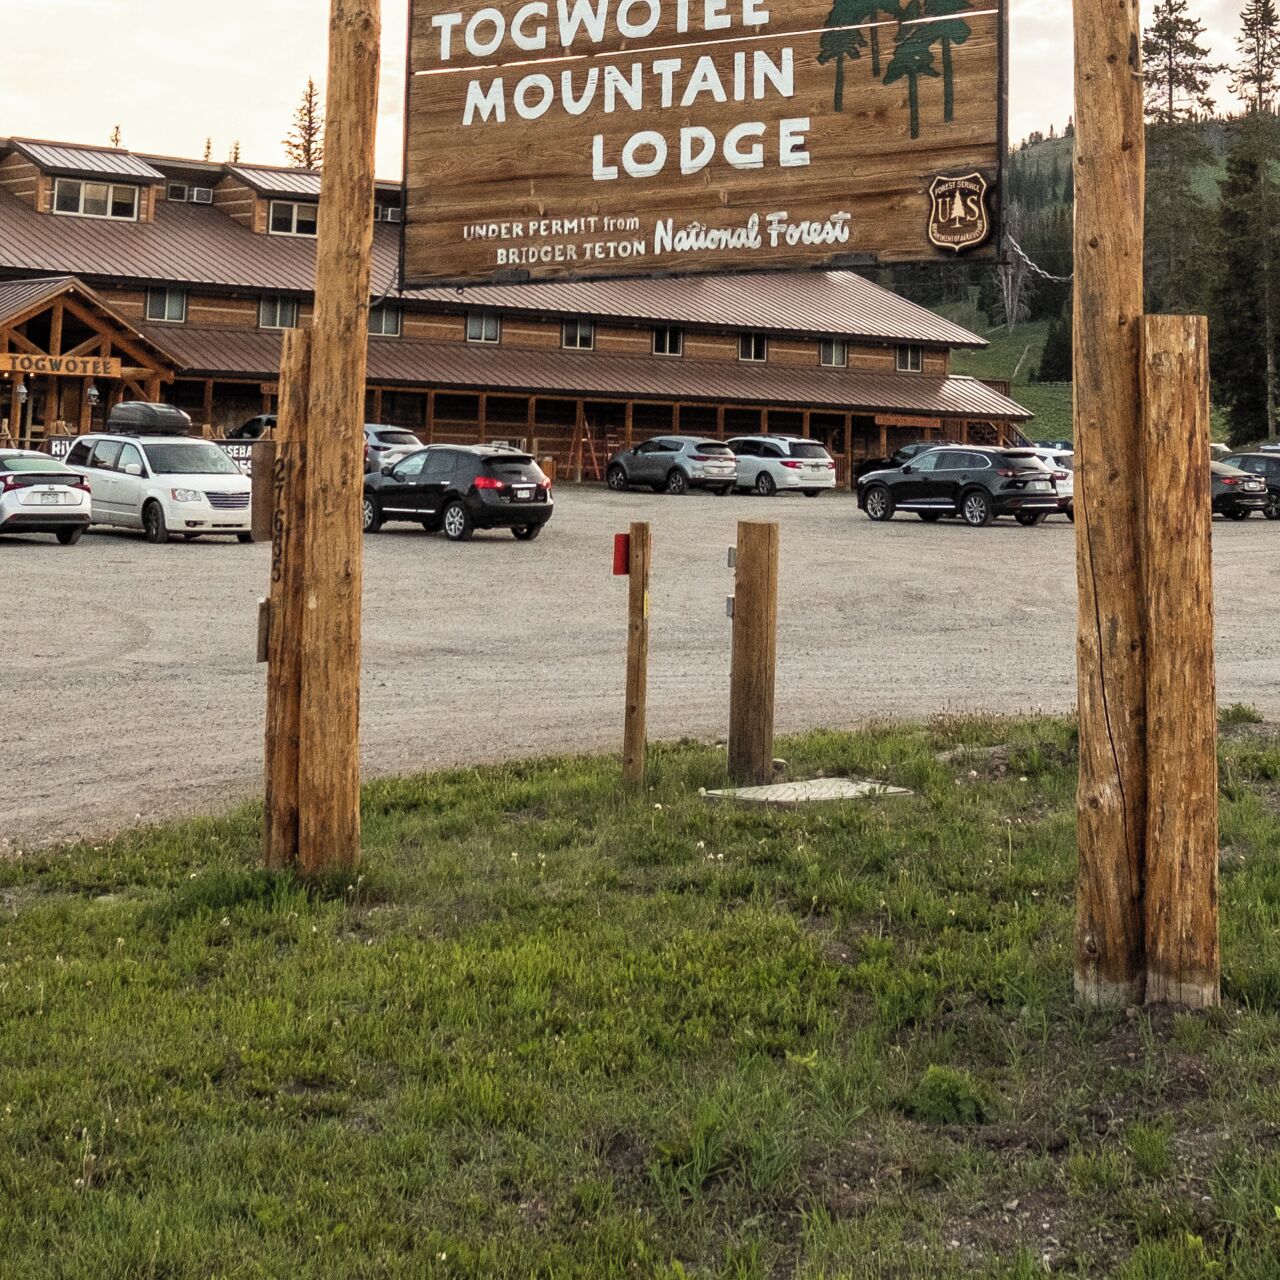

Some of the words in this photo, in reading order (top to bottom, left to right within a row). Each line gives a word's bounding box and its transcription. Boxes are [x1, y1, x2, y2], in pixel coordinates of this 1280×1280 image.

[462, 47, 794, 125] MOUNTAIN
[592, 117, 811, 180] LODGE
[463, 222, 524, 240] UNDER
[528, 217, 599, 237] PERMIT
[603, 216, 640, 232] from
[654, 213, 762, 255] National
[765, 210, 851, 248] Forest
[496, 244, 578, 265] BRIDGER
[583, 240, 646, 260] TETON
[9, 355, 112, 375] TOGWOTEE
